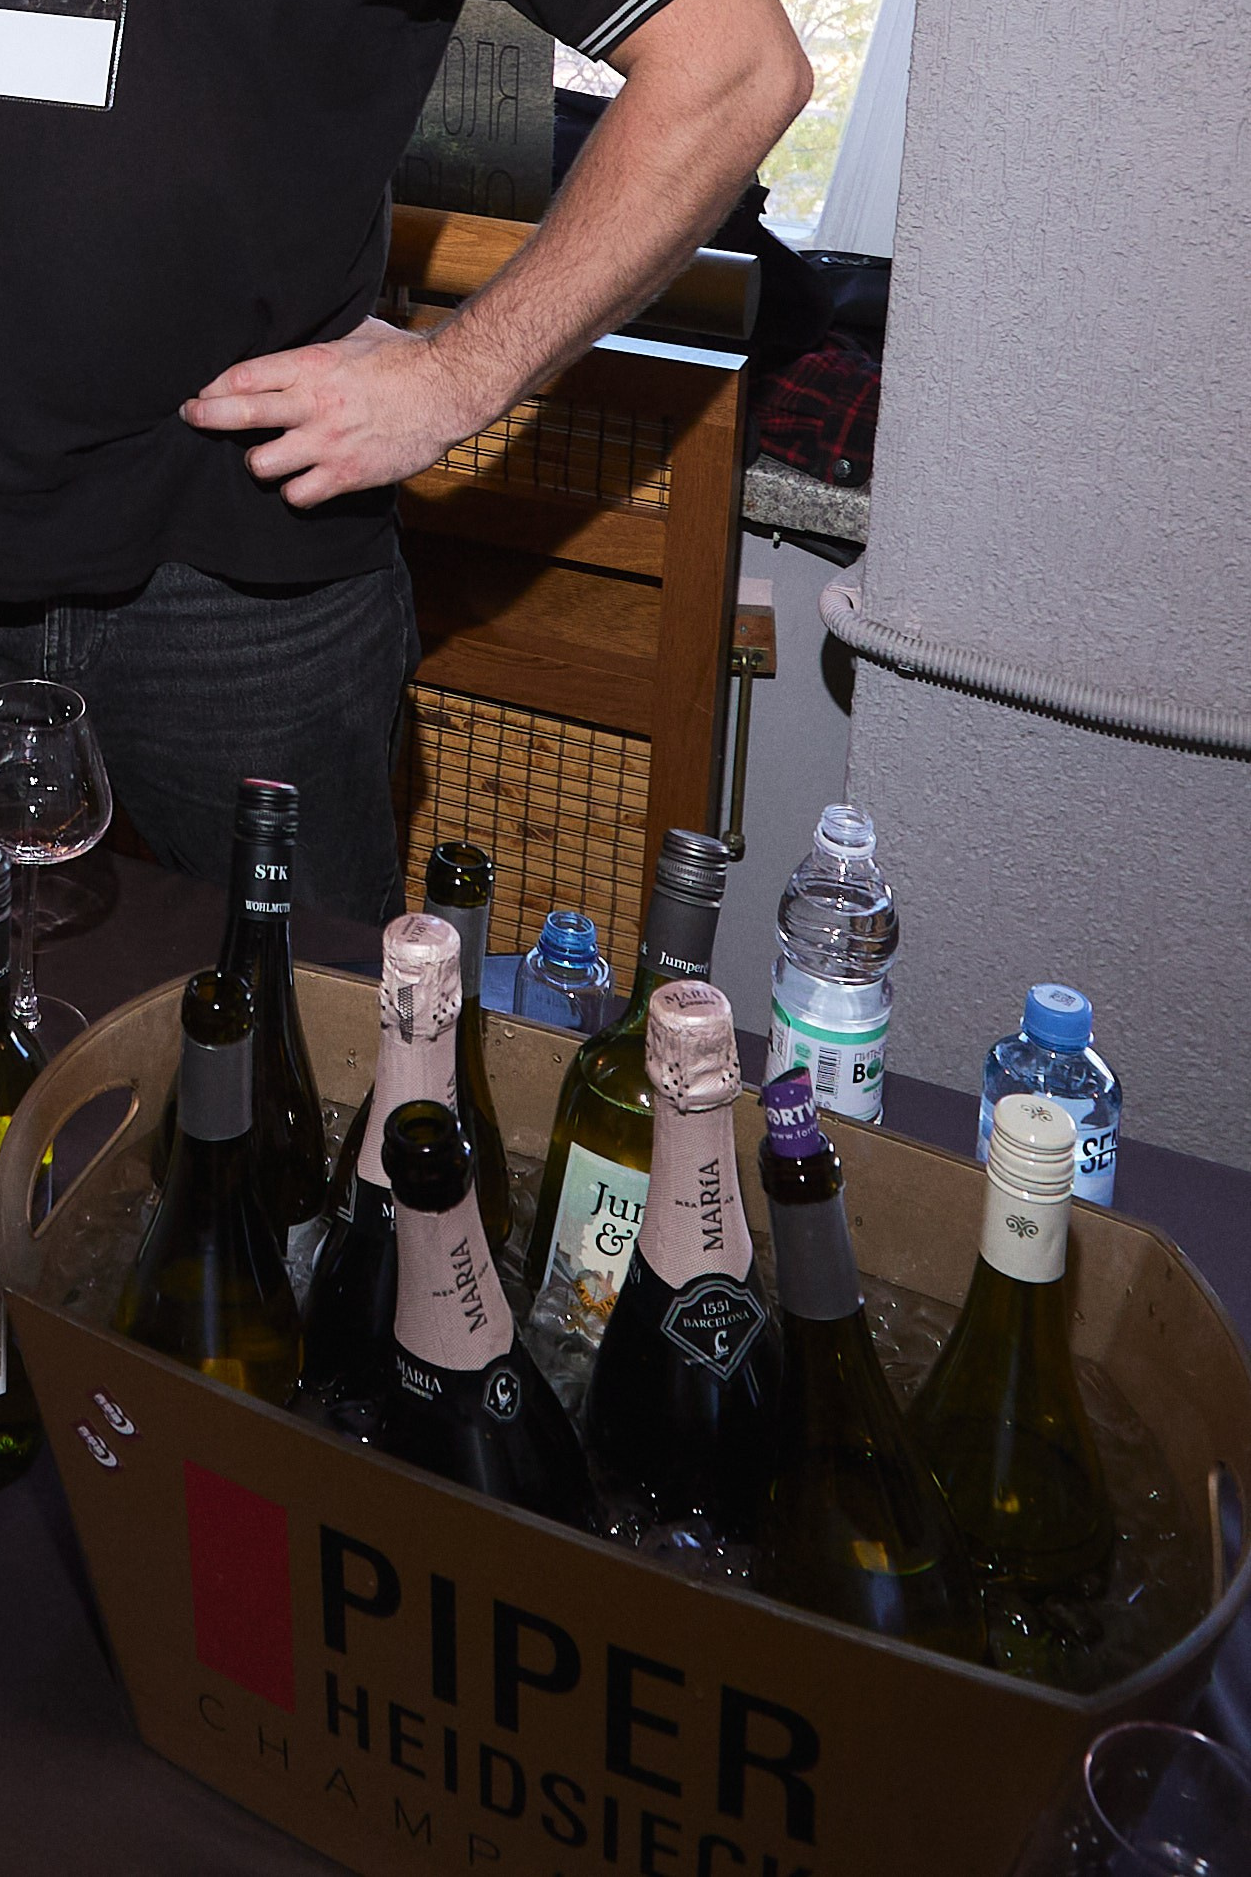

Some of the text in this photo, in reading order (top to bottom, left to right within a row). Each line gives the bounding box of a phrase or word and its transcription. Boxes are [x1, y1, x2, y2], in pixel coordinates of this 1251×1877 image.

[254, 864, 288, 880] STK
[595, 1222, 633, 1256] &
[702, 1299, 730, 1316] 1551
[683, 1311, 750, 1329] BARCELONA
[320, 1524, 820, 1846] PIPER
